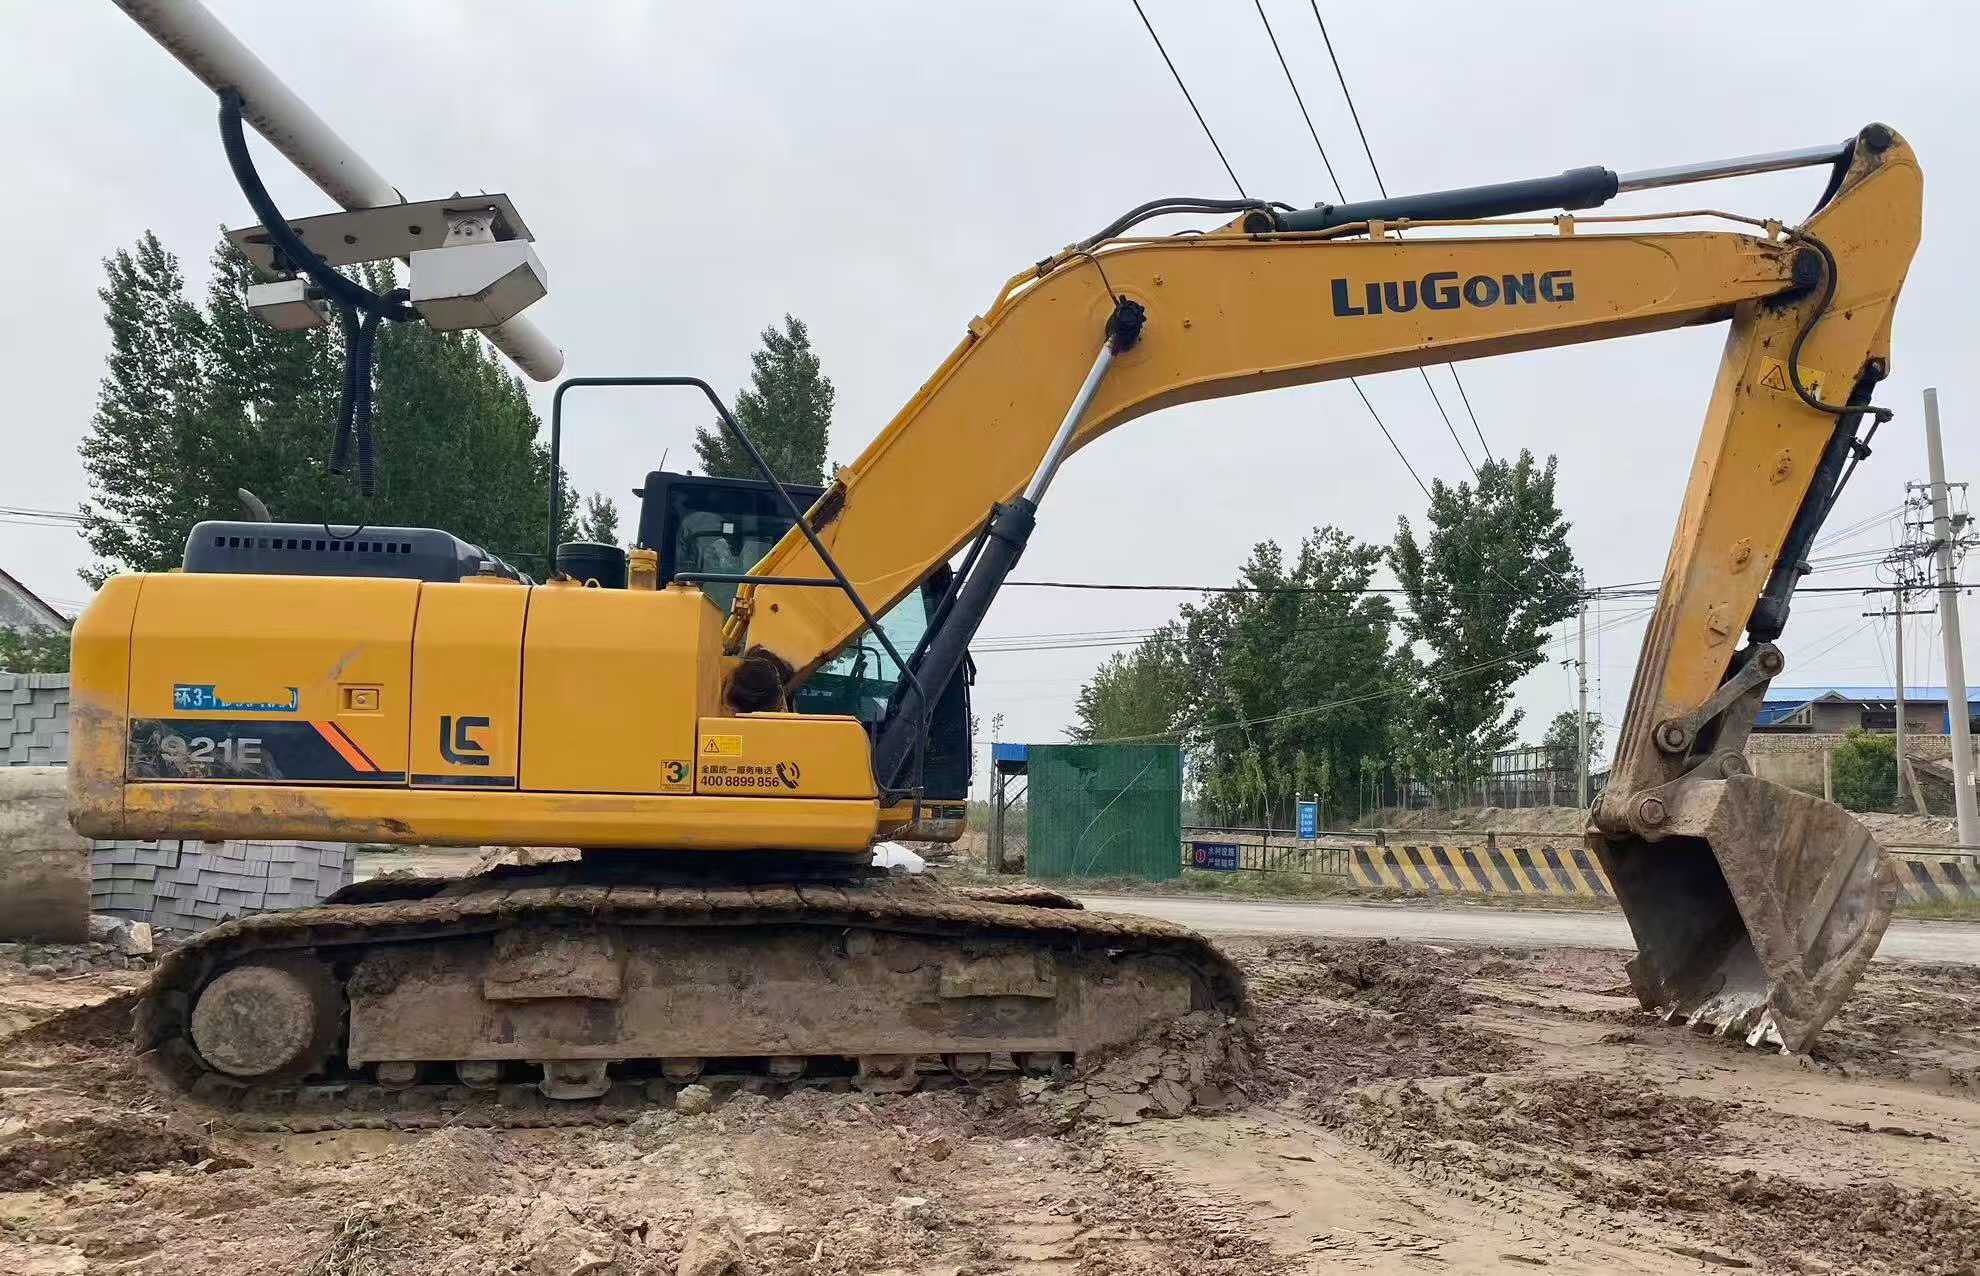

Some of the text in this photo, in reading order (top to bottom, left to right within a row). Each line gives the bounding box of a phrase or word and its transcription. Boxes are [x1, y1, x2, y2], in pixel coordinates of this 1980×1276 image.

[160, 735, 262, 764] 921E
[700, 775, 723, 787] 400
[725, 776, 755, 787] 8899
[757, 777, 780, 788] 856
